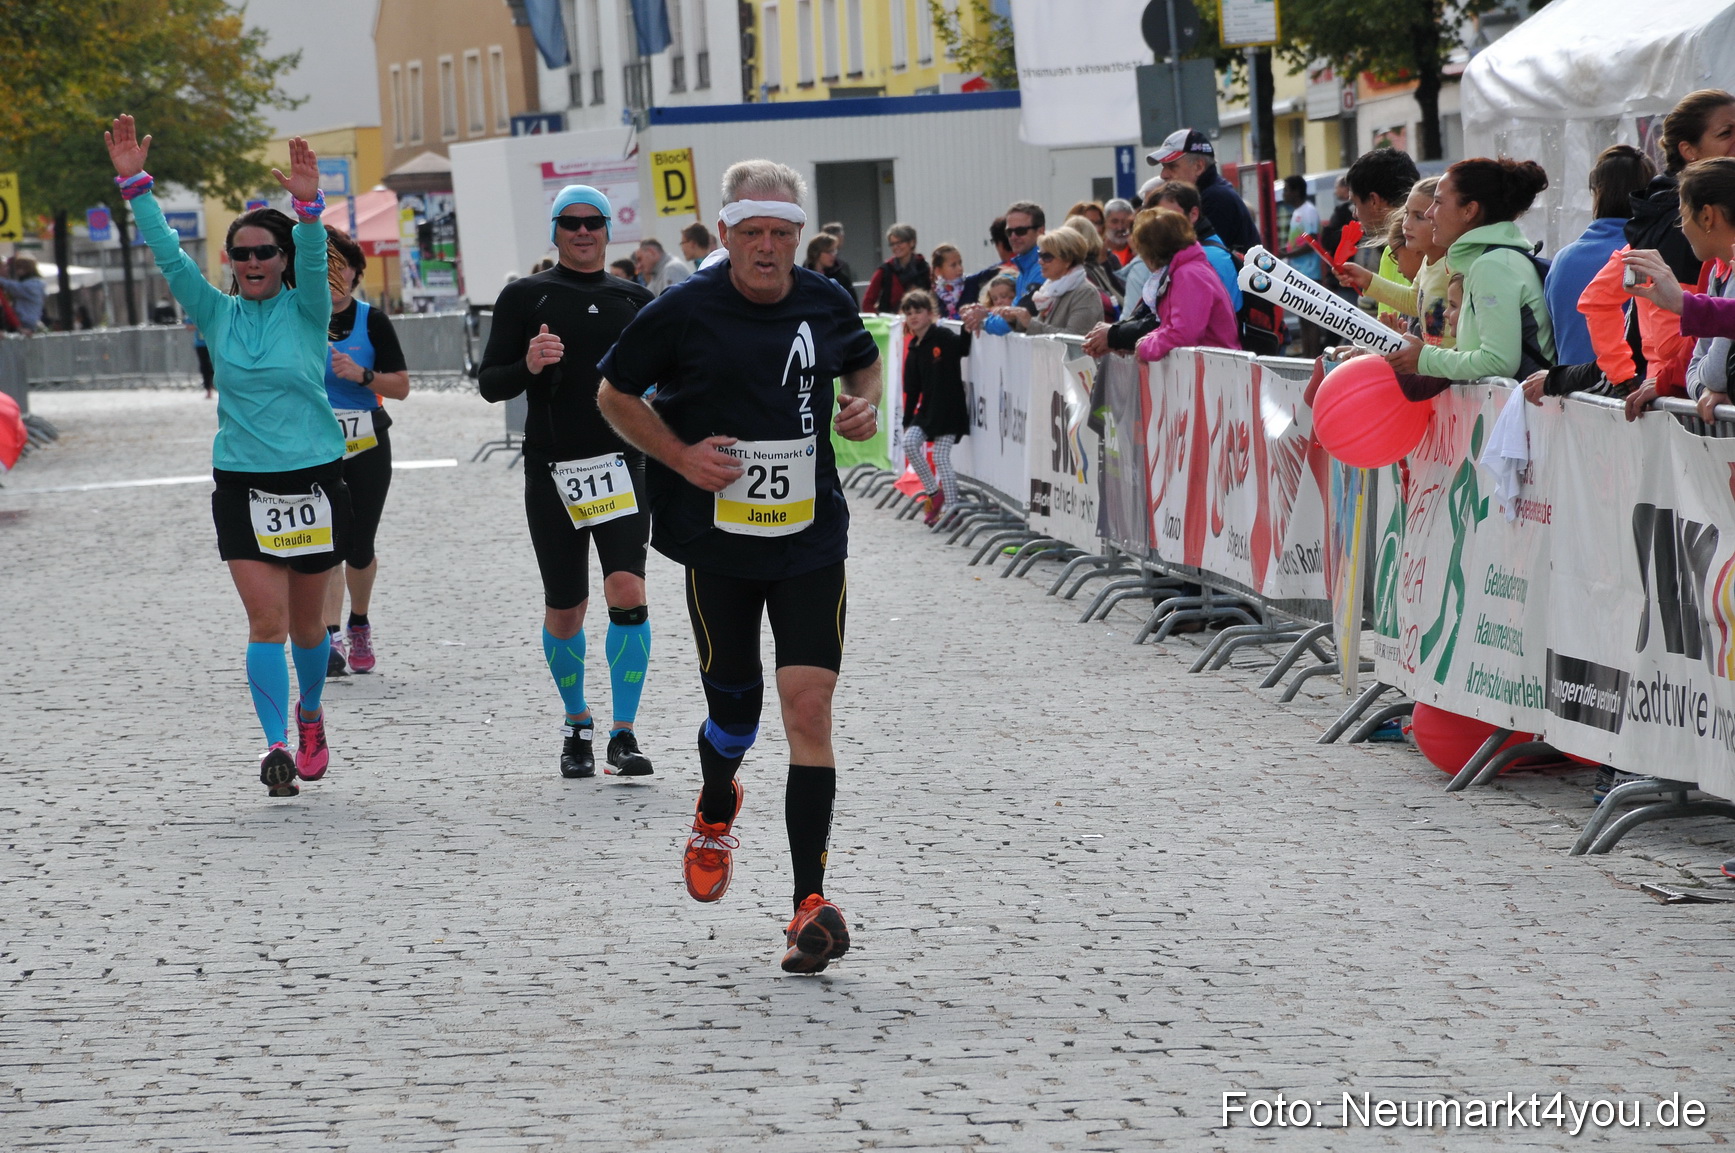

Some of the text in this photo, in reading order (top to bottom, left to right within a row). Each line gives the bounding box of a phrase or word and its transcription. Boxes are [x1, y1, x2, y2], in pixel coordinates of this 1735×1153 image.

[654, 151, 690, 165] Block
[663, 169, 687, 202] D
[753, 449, 803, 460] Neumarkt
[576, 461, 613, 473] Neumarkt
[566, 471, 614, 502] 311
[747, 464, 790, 500] 25
[266, 503, 317, 533] 310
[747, 508, 787, 523] Janke
[273, 533, 313, 548] Claudia
